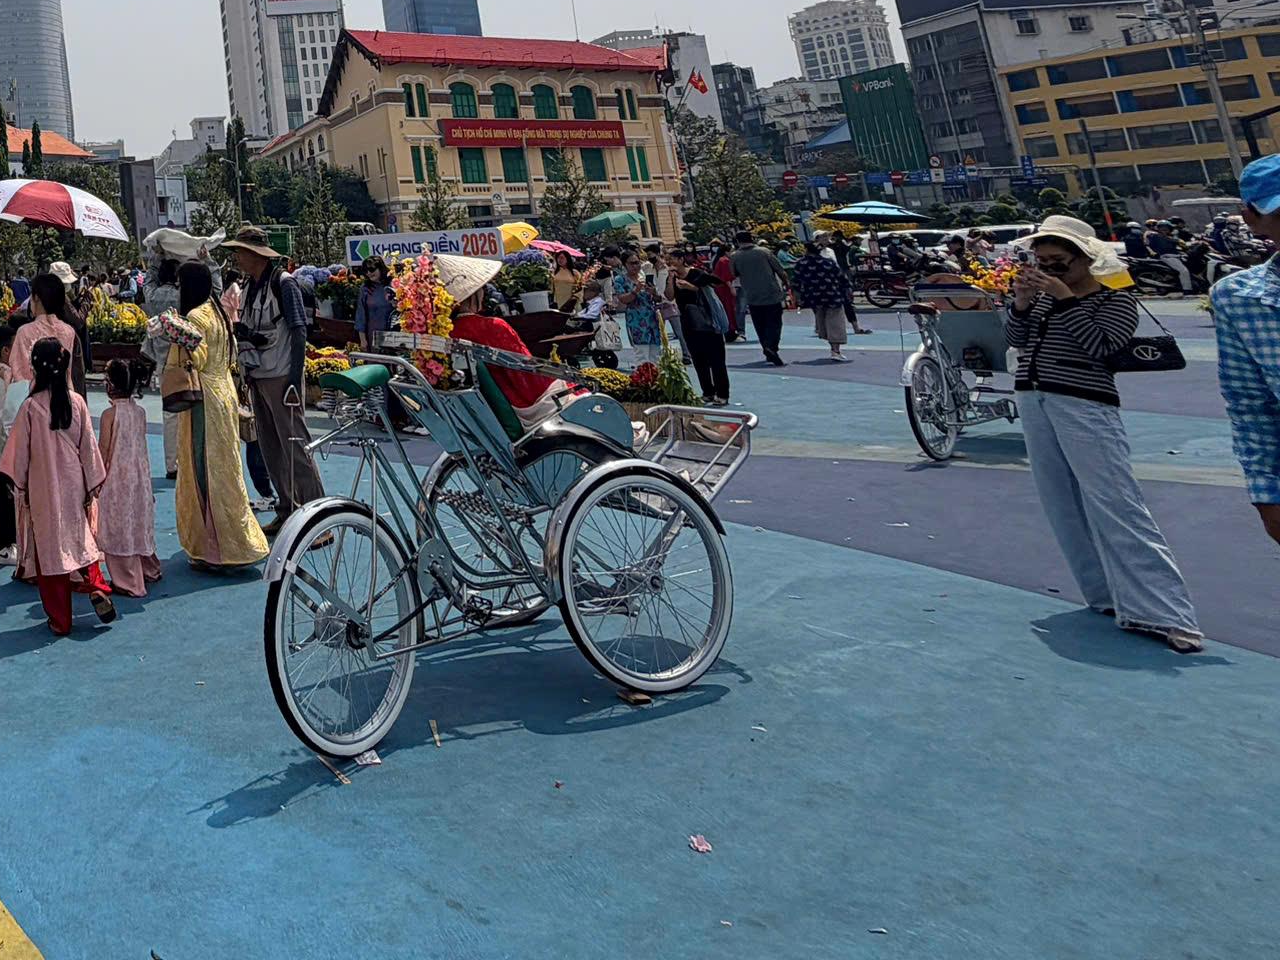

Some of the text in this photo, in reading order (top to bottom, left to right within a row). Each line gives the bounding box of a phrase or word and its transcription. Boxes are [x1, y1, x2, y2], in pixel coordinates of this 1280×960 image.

[863, 77, 894, 93] VPBank
[372, 242, 422, 256] KHANG
[461, 232, 499, 256] 2026
